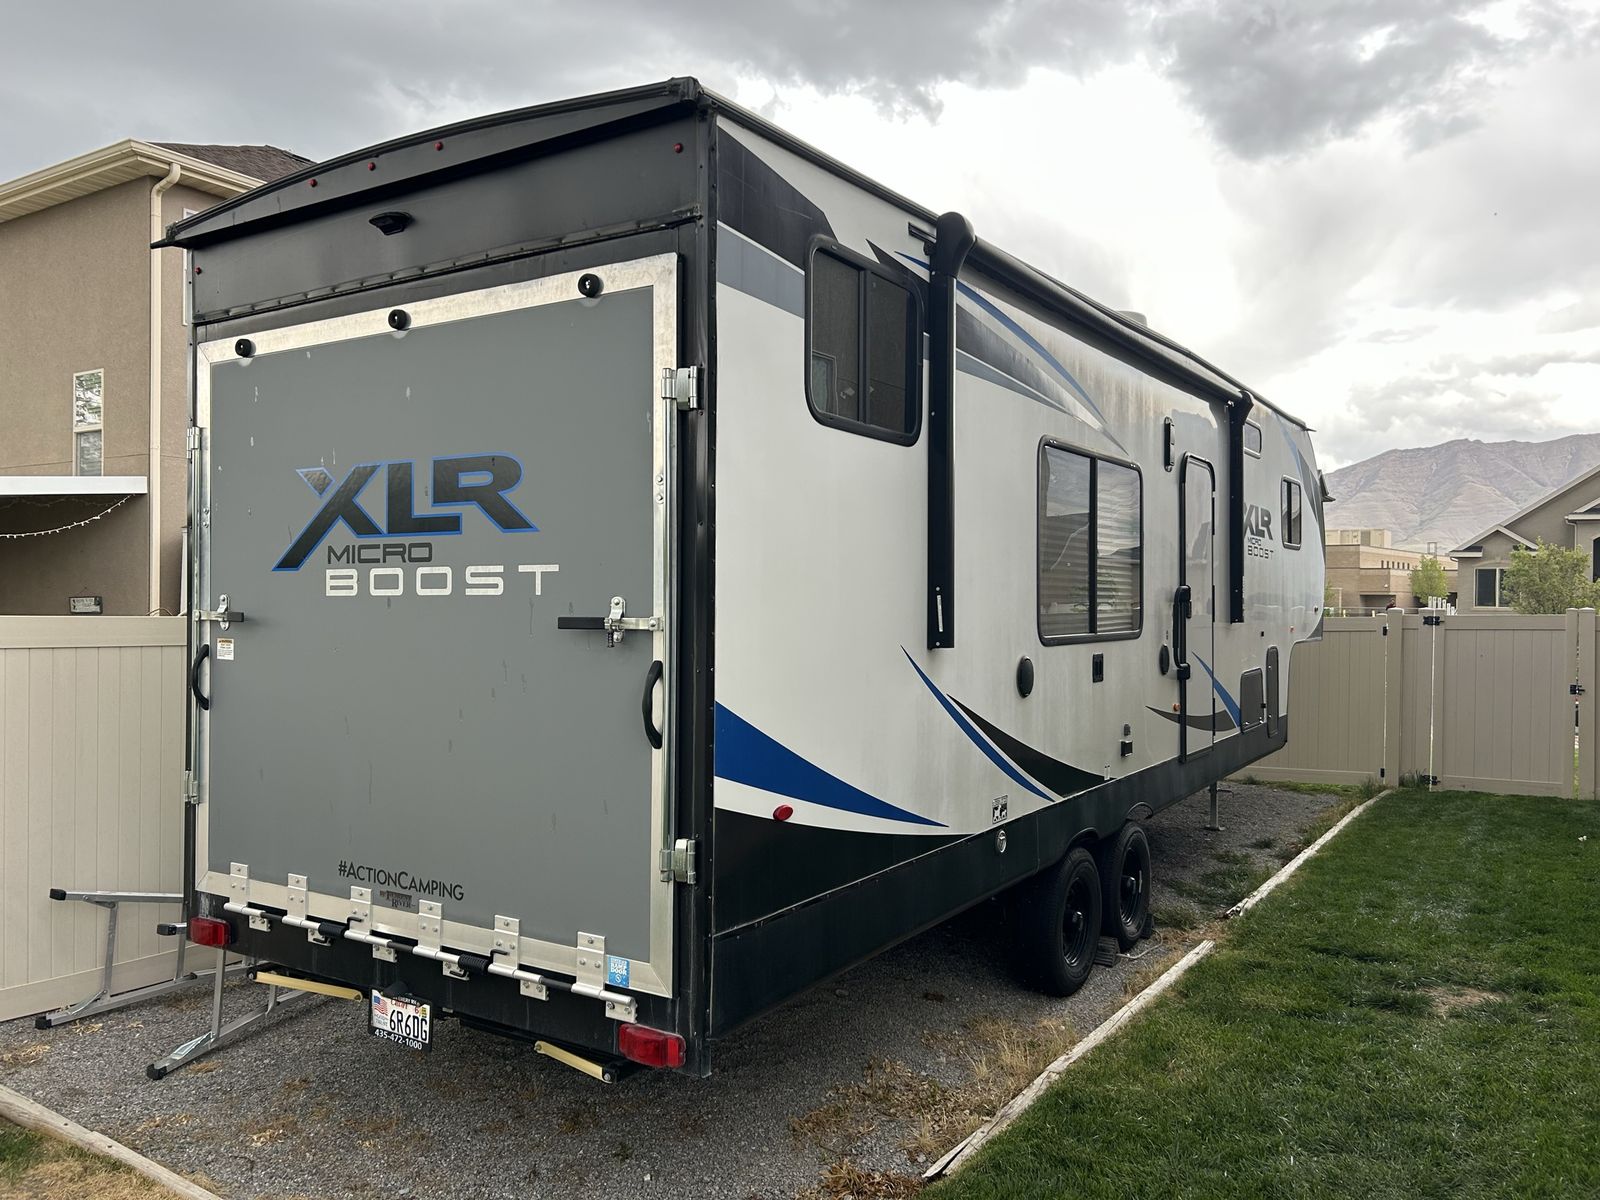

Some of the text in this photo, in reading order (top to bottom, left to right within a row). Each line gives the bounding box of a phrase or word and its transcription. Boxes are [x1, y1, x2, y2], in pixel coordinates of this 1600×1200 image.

[272, 452, 540, 572] XLR
[327, 542, 433, 564] MICRO
[1248, 545, 1274, 559] BOOST
[325, 564, 559, 597] BOOST
[389, 1009, 428, 1041] 6R6DG
[374, 1028, 423, 1050] 435-472-1000
